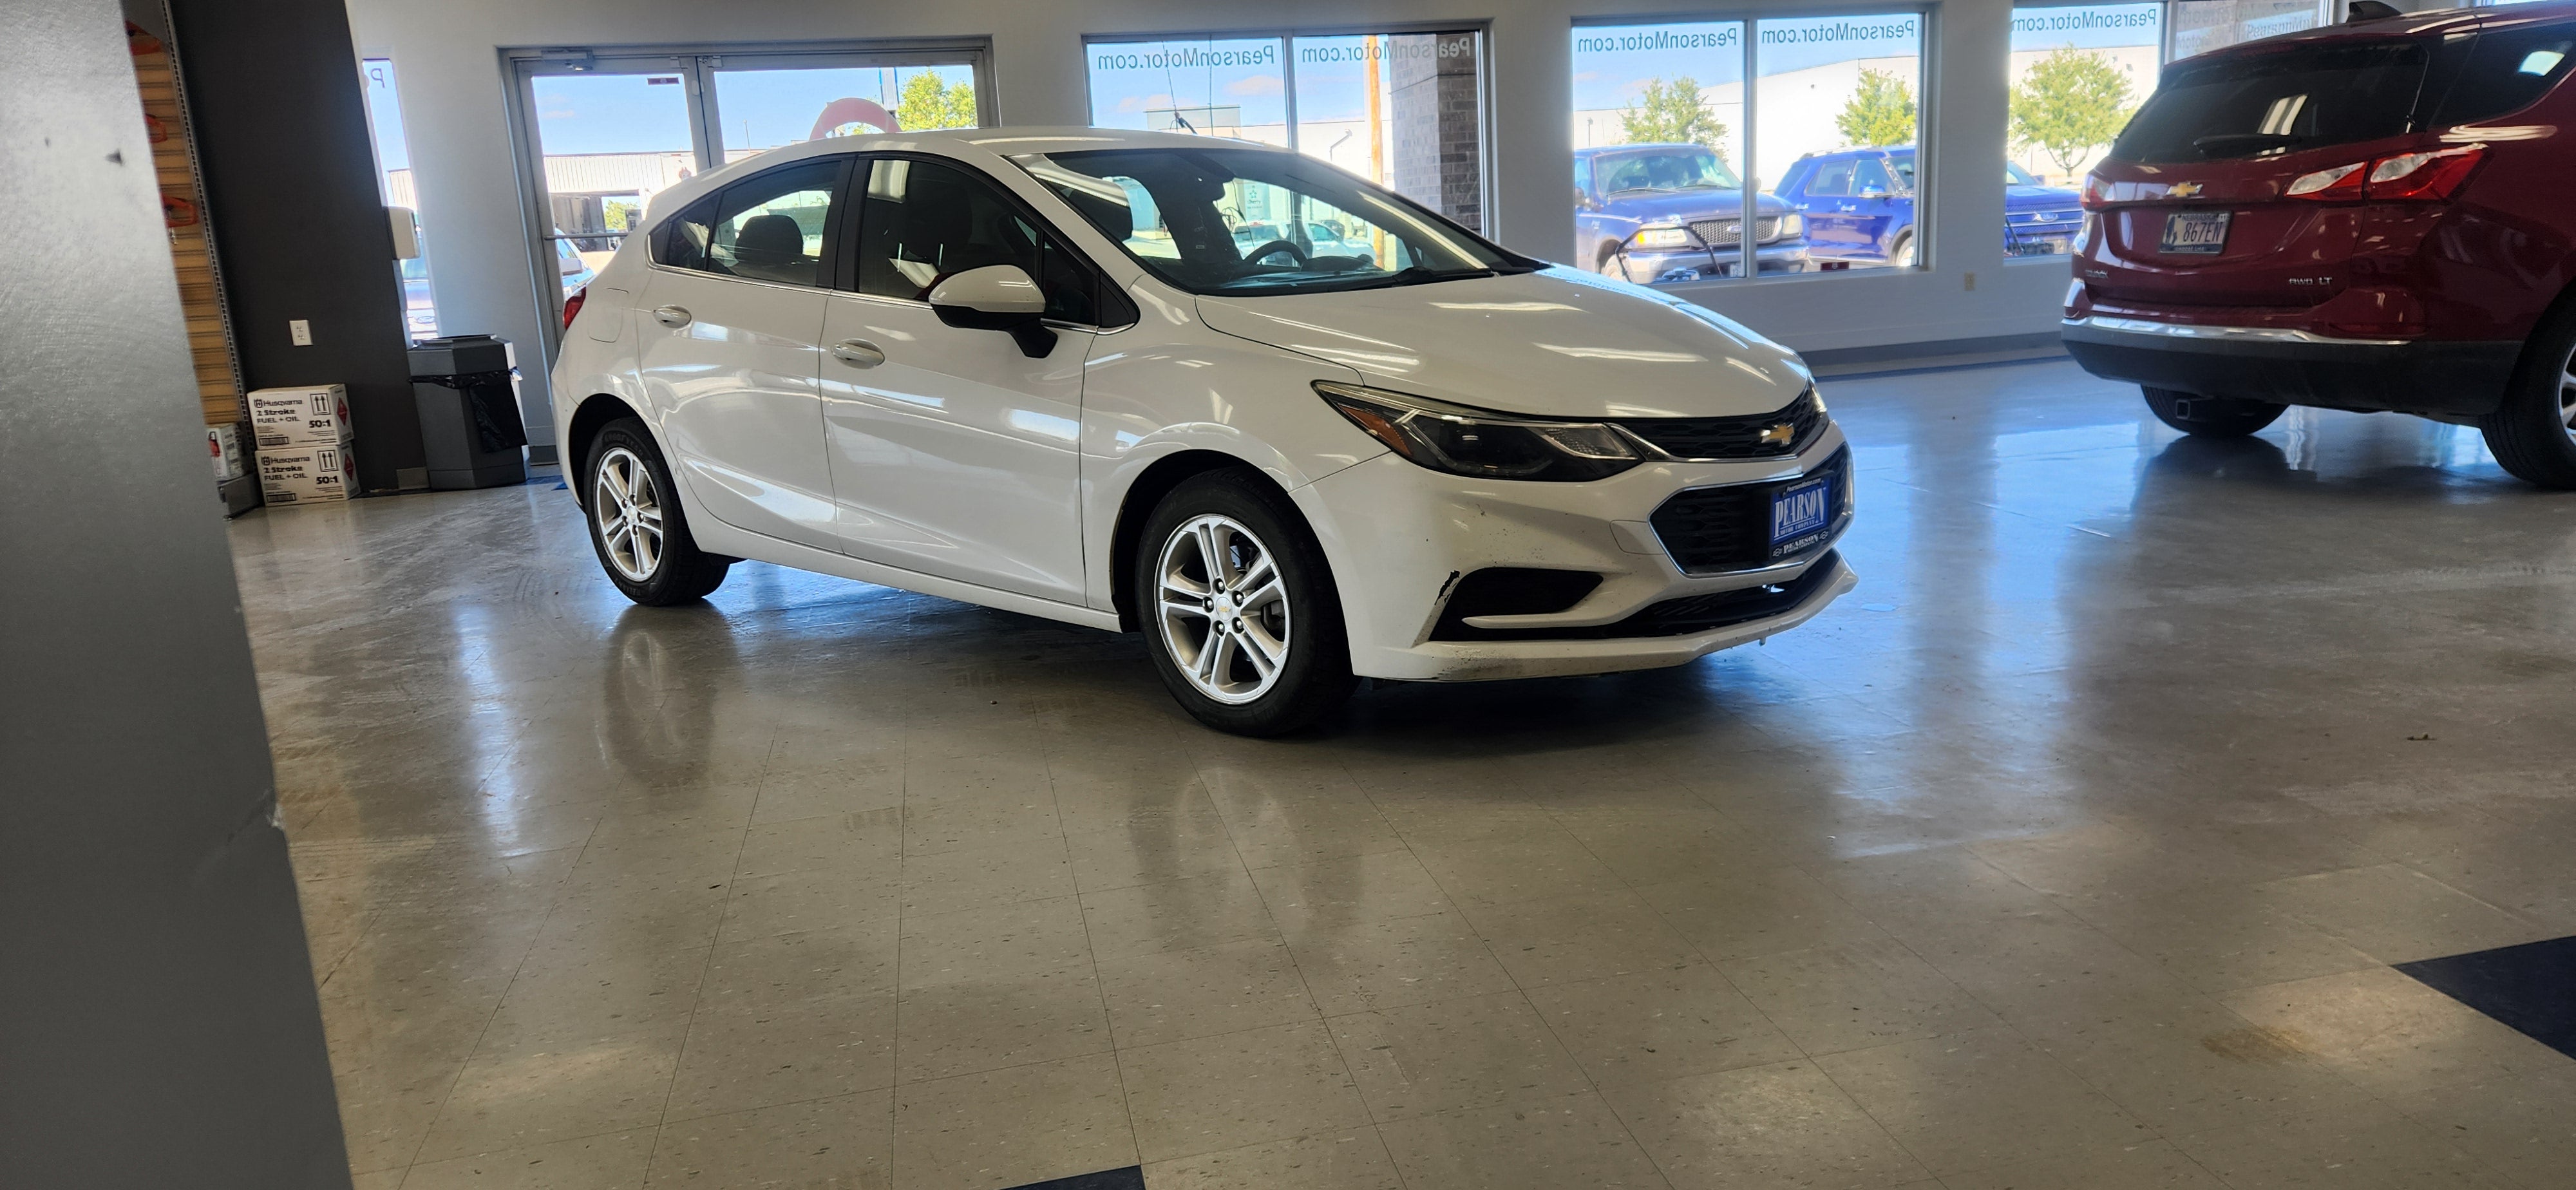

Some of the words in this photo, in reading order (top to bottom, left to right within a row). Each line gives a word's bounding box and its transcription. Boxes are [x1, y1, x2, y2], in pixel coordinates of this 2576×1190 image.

[2183, 222, 2224, 242] 867EN
[263, 399, 303, 407] Husqvarna
[308, 419, 331, 428] 50:1
[270, 455, 310, 464] Husqvarna
[316, 475, 339, 484] 50:1
[1774, 487, 1826, 538] PEARSON
[1783, 534, 1819, 554] PEARSON
